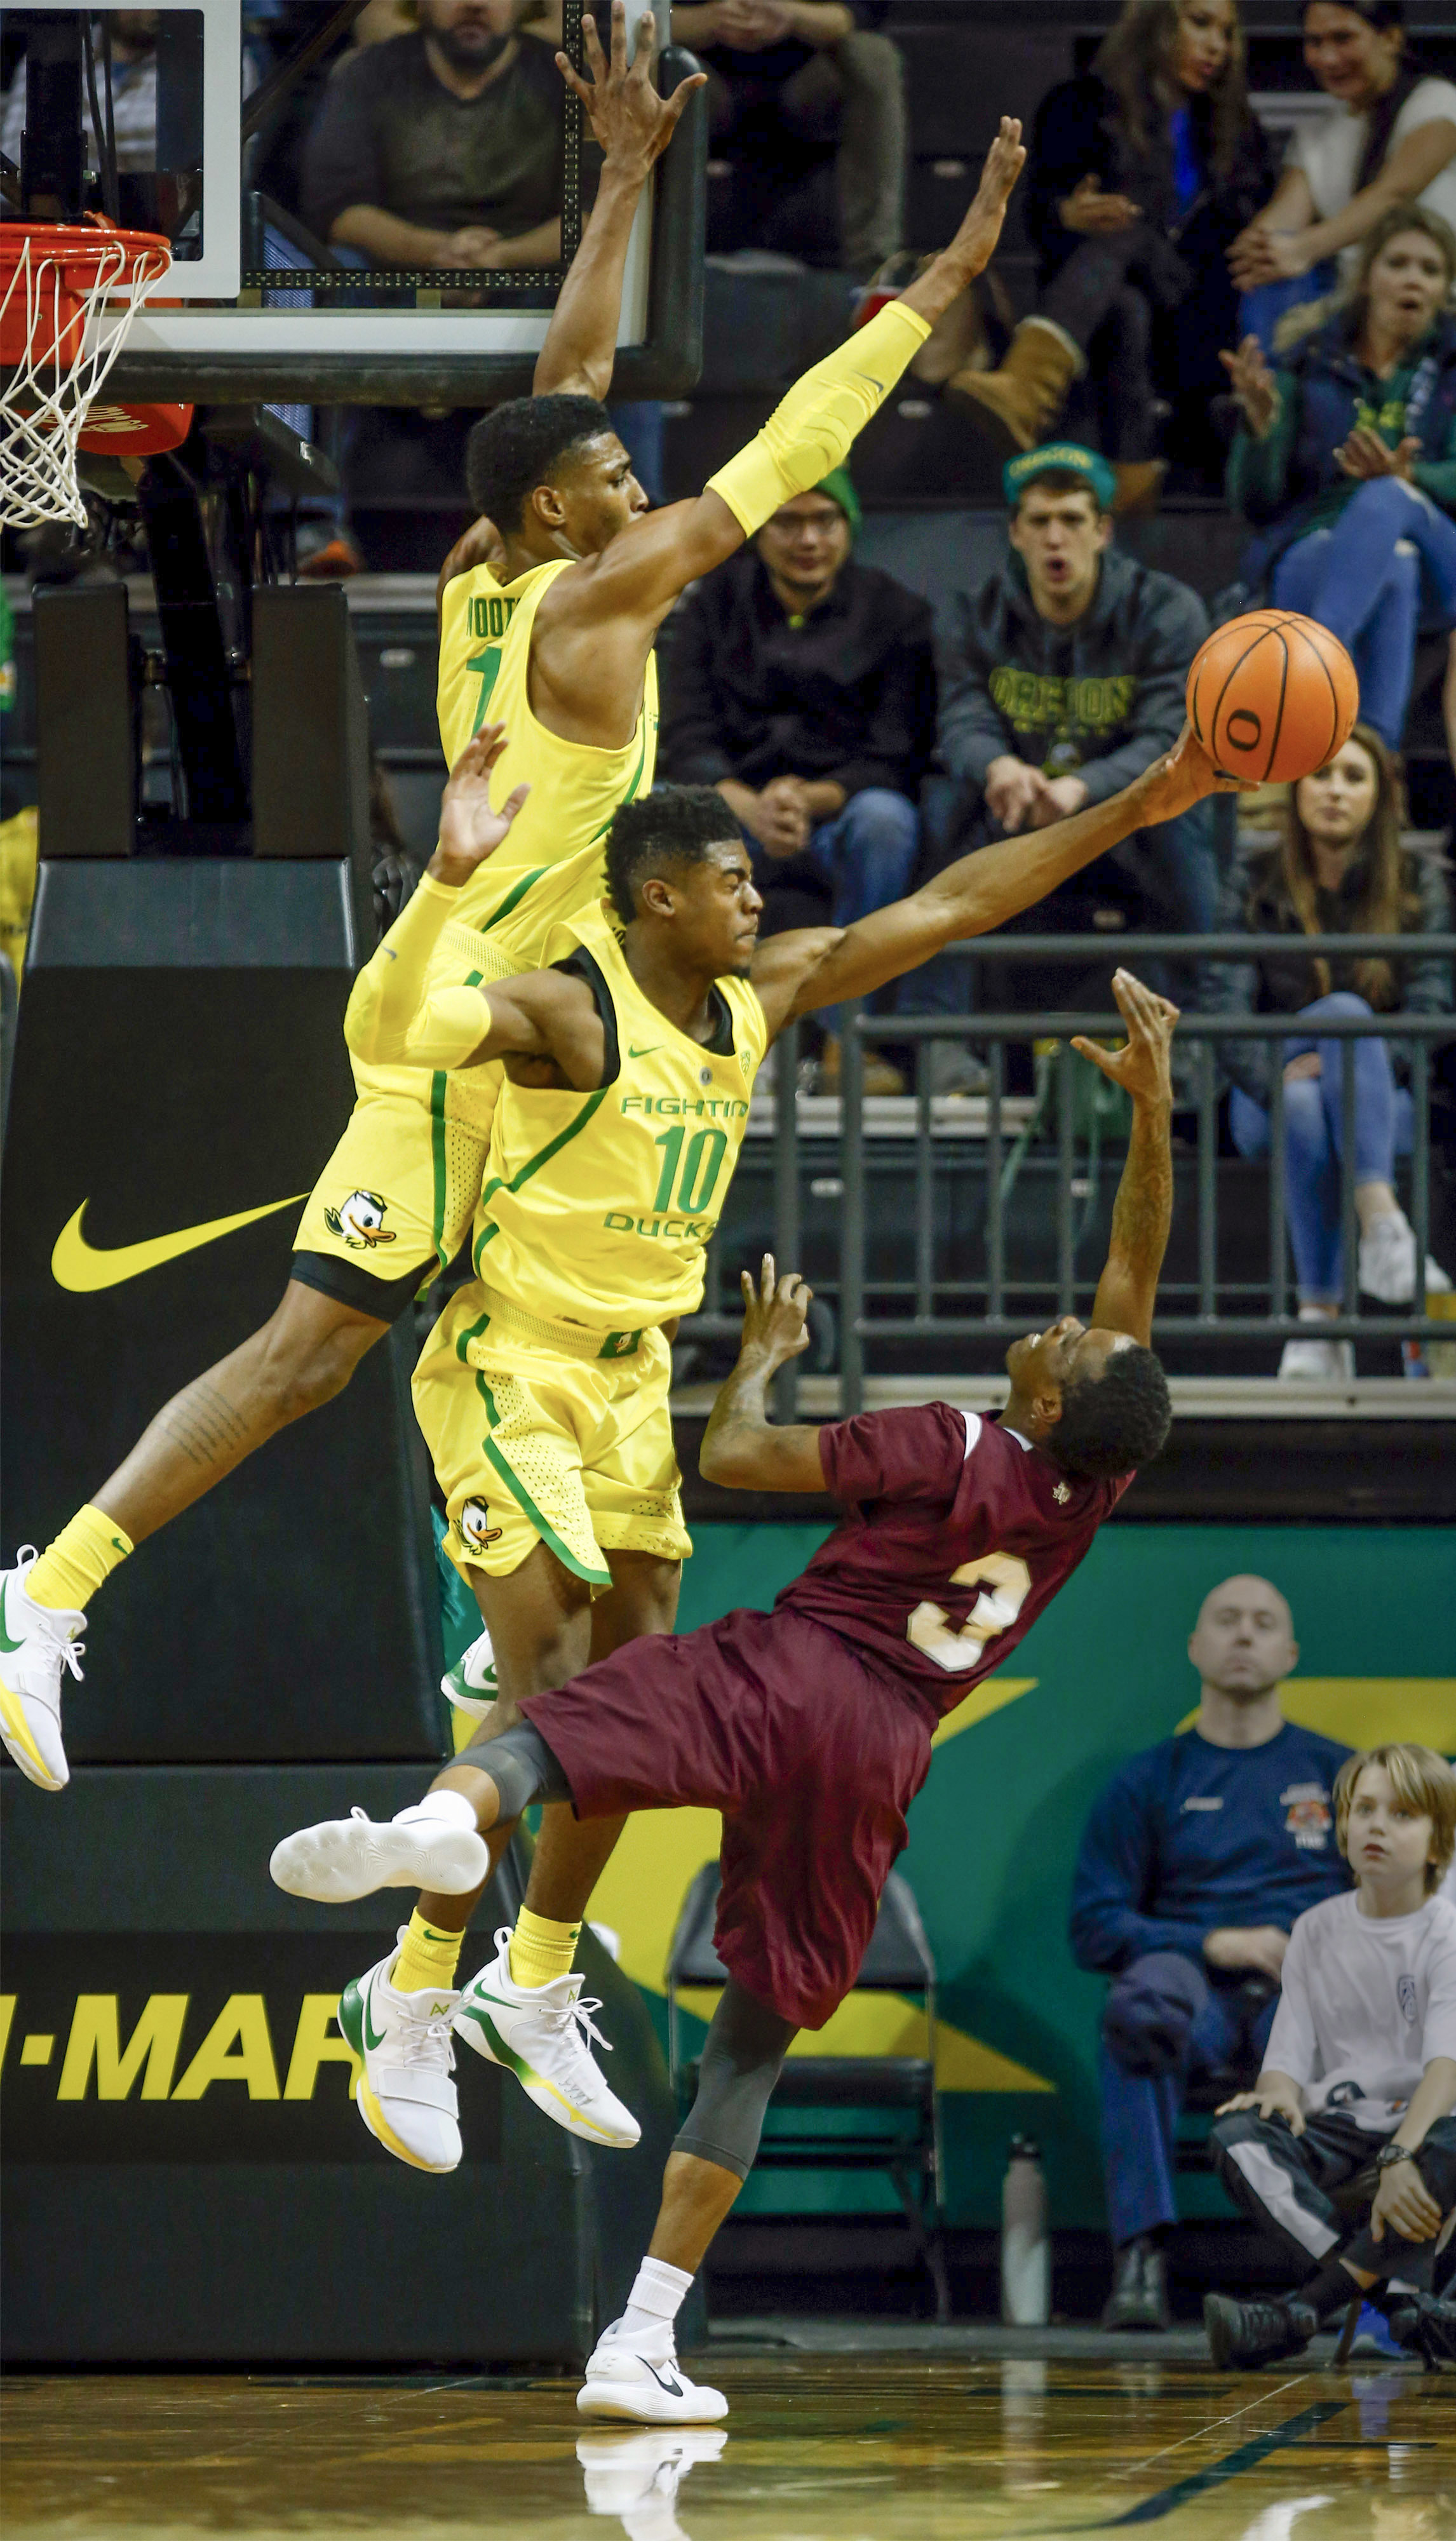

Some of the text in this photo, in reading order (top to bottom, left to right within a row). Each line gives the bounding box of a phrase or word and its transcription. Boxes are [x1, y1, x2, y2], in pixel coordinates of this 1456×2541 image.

[466, 596, 520, 637] OOT
[466, 645, 502, 741] 1
[1227, 708, 1261, 752] O
[652, 1126, 727, 1214] 10
[906, 1551, 1032, 1672] 3
